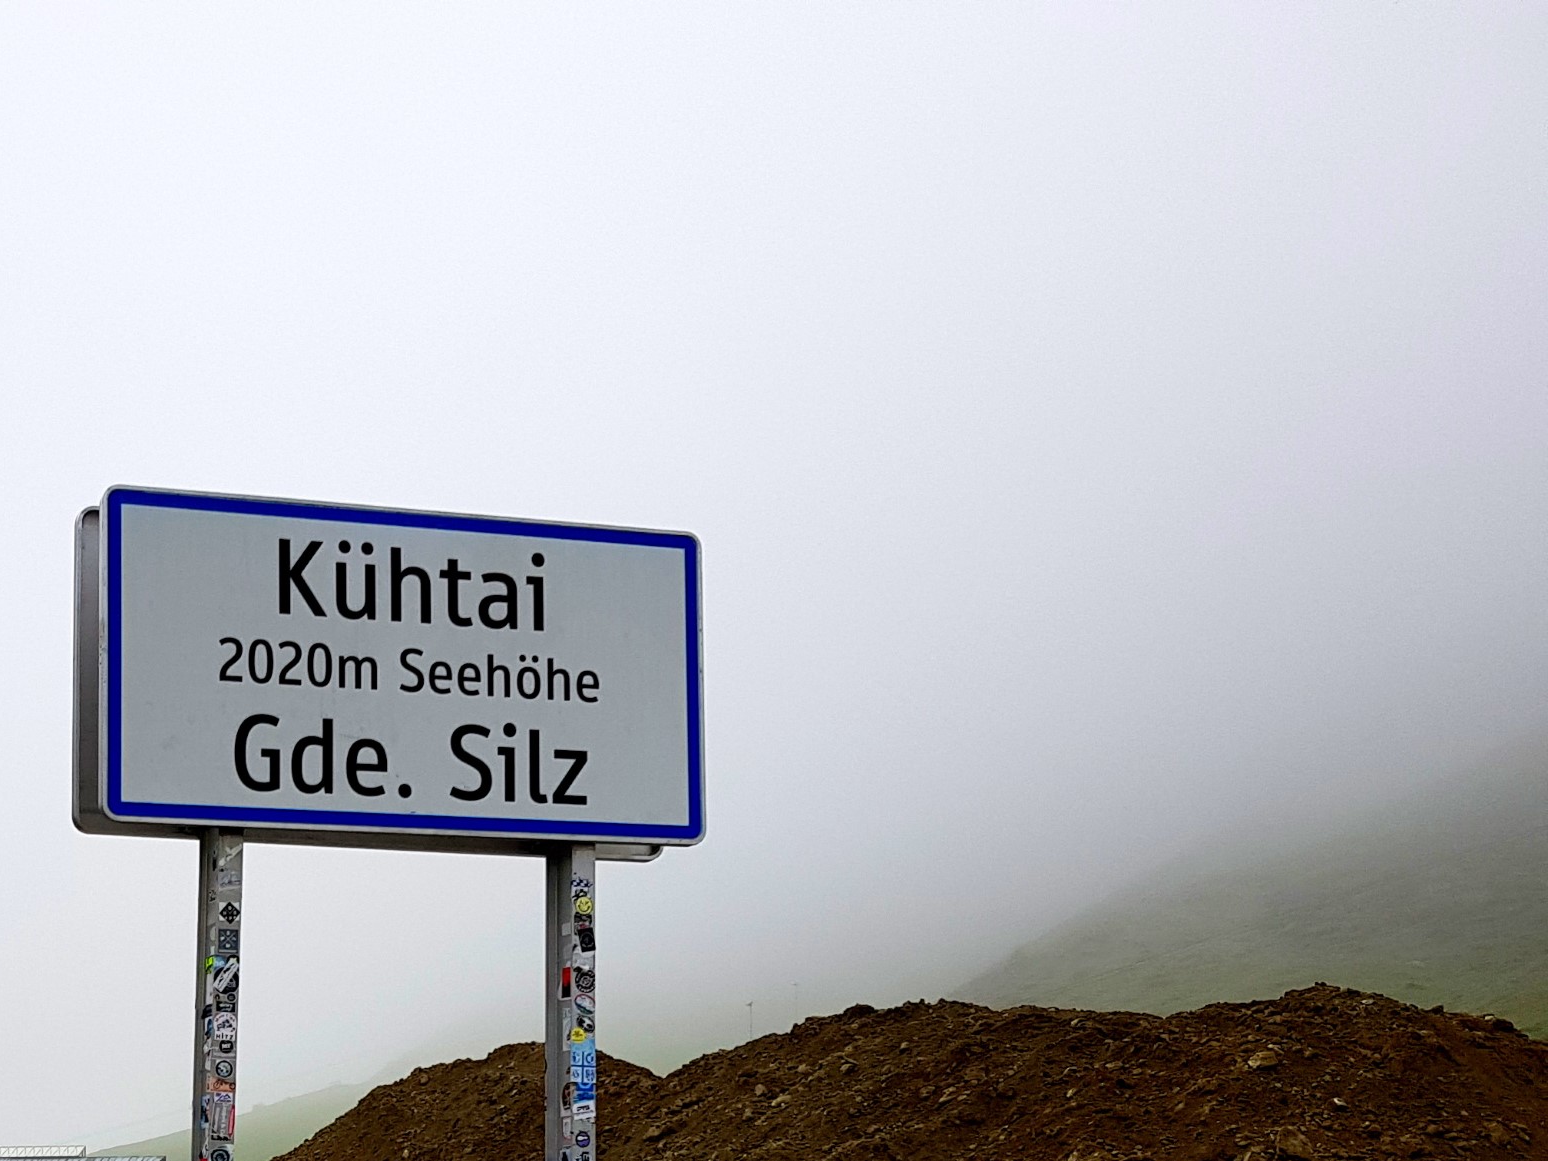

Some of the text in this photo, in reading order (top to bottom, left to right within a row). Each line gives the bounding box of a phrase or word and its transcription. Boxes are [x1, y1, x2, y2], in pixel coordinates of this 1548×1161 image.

[276, 537, 546, 632] Kühtai
[218, 637, 600, 704] 2020m Seehöhe
[233, 713, 589, 806] Gde. Silz
